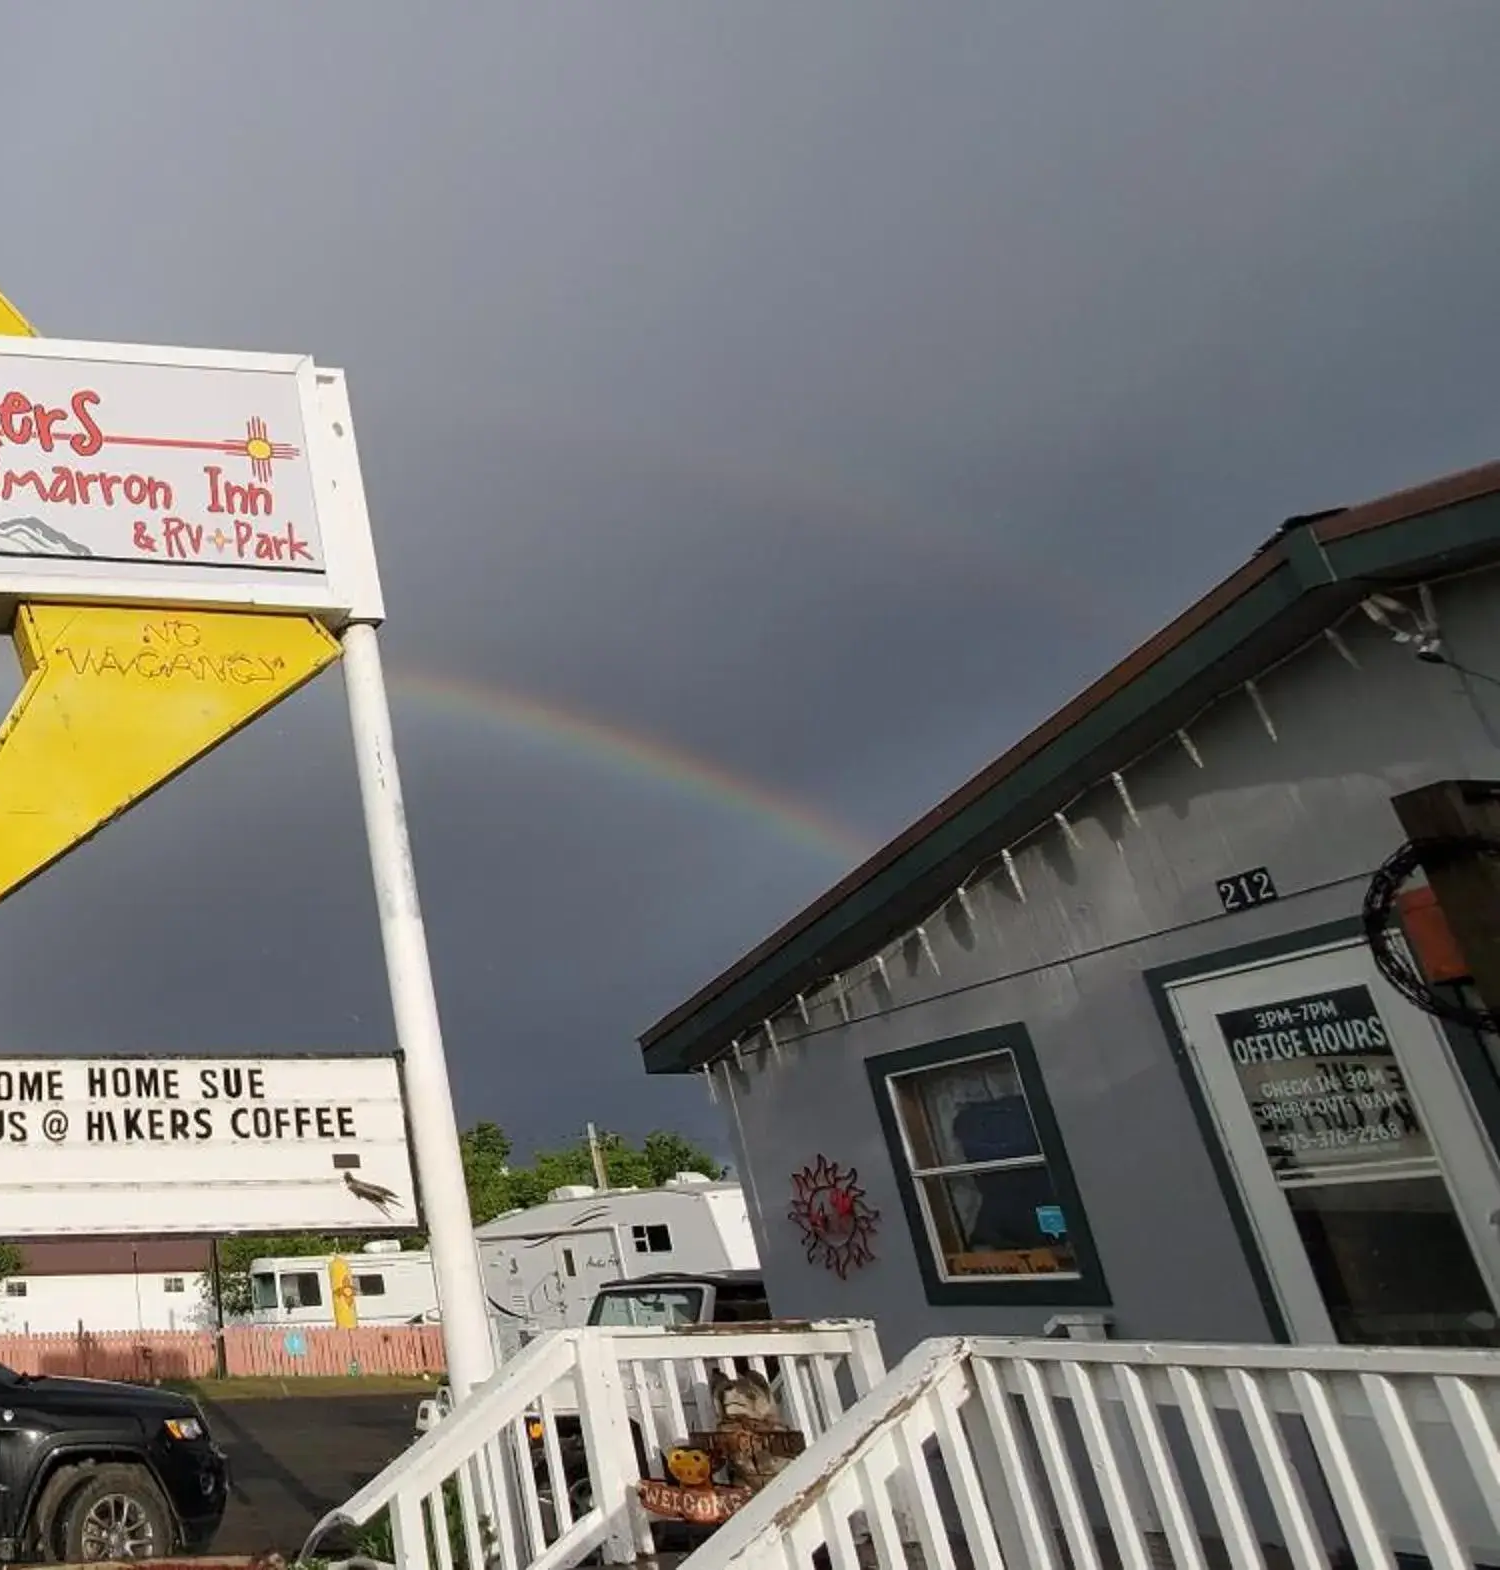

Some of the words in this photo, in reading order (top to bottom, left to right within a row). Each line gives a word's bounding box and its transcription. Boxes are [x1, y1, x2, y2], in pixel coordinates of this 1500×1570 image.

[204, 465, 273, 515] Inn
[132, 521, 157, 553] &
[164, 517, 203, 558] RV
[235, 520, 315, 561] Park
[143, 620, 201, 648] NO
[58, 647, 284, 685] VACANCY
[1219, 873, 1273, 909] 212
[1255, 1000, 1339, 1030] 3PM-7PM
[1232, 1028, 1307, 1065] OFFICE
[1307, 1015, 1387, 1056] HOURS
[87, 1067, 179, 1099] HOME
[200, 1068, 265, 1099] SUE
[1260, 1077, 1313, 1099] CHECK
[1345, 1068, 1386, 1089] 3PM
[42, 1109, 69, 1141] @
[87, 1108, 213, 1142] HIKERS
[231, 1107, 357, 1139] COFFEE
[642, 1486, 742, 1518] WELCOME
